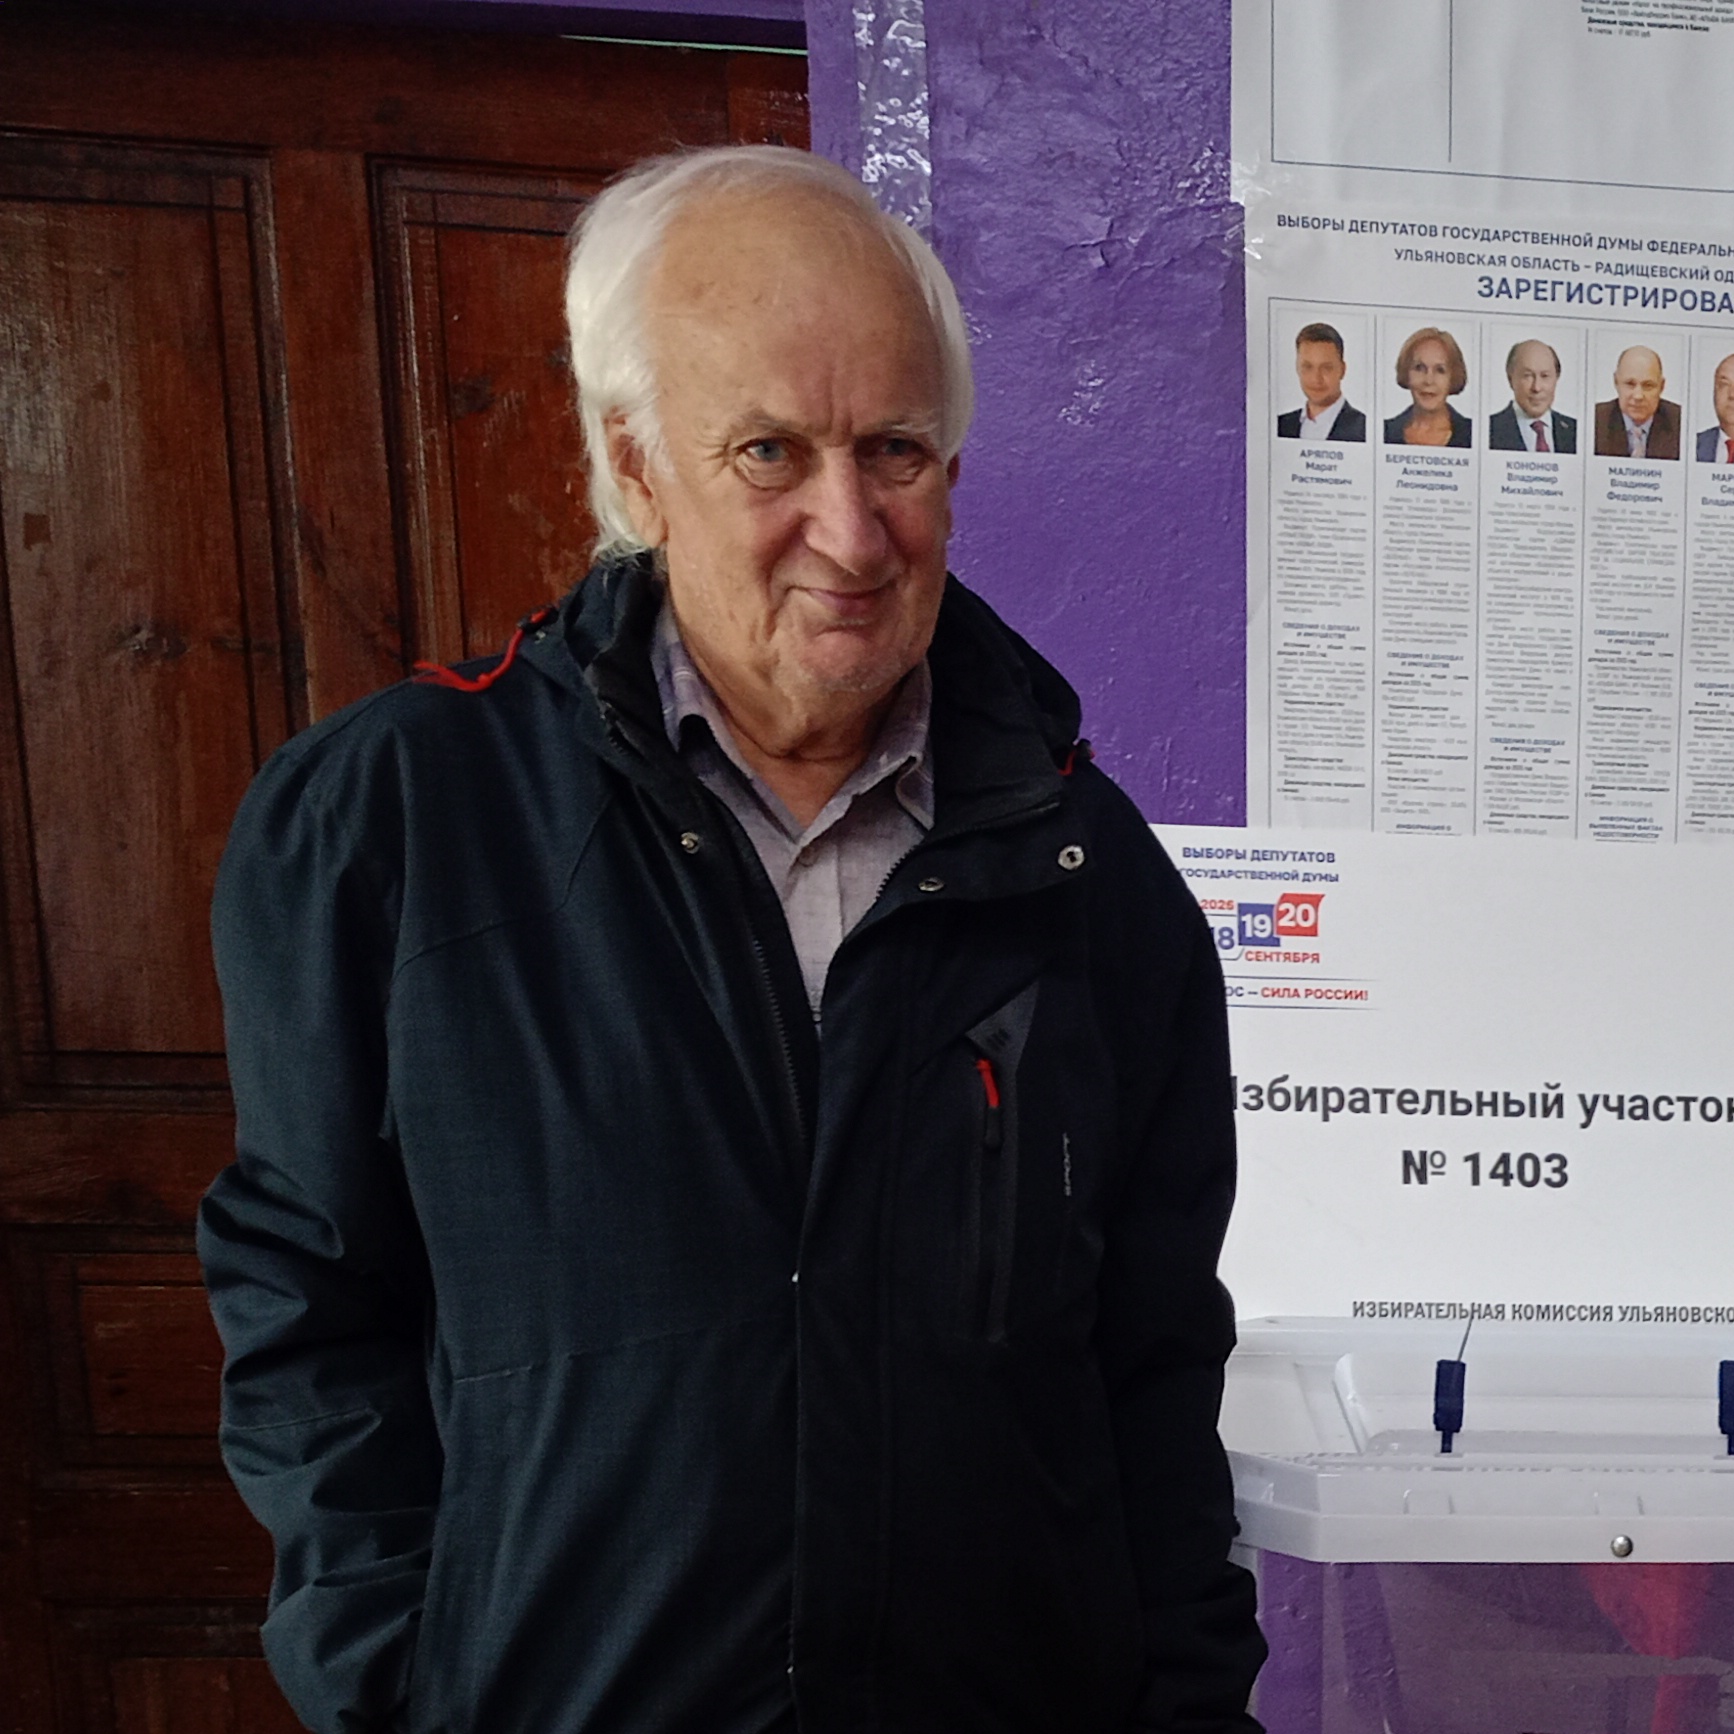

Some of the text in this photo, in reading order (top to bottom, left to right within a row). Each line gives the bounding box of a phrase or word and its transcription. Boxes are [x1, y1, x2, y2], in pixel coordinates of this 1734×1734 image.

[1277, 214, 1344, 231] ВЫБОРЫ
[1348, 220, 1438, 238] ДЕПУТАТОВ
[1442, 226, 1593, 248] ГОСУДАРСТВЕННОЙ
[1597, 236, 1643, 251] ДУМЫ
[1394, 248, 1506, 268] УЛЬЯНОВСКАЯ
[1511, 257, 1580, 273] ОБЛАСТЬ
[1595, 261, 1710, 282] РАДИЩЕВСКИЙ
[1300, 449, 1344, 460] АРЯПОВ
[1385, 453, 1469, 467] БЕРЕСТОВСКАЯ
[1305, 461, 1337, 473] Марат
[1402, 467, 1453, 478] Анжелика
[1506, 461, 1559, 472] КОНОНОВ
[1608, 467, 1662, 479] МАЛИНИН
[1291, 474, 1352, 486] Растямович
[1507, 473, 1558, 485] Владимир
[1610, 478, 1660, 490] Владимир
[1396, 480, 1458, 492] Леонидовна
[1501, 485, 1563, 496] Михайлович
[1607, 491, 1663, 504] Федорович
[1183, 847, 1335, 863] ВЫБОРЫ ДЕПУТАТОВ
[1179, 868, 1339, 883] ГОСУДАРСТВЕННОЙ ДУМЫ
[1241, 913, 1273, 938] 19
[1278, 902, 1316, 928] 20
[1245, 950, 1320, 964] СЕНТЯБРЯ
[1261, 986, 1368, 1001] СИЛА РОССИИ!
[1401, 1149, 1570, 1190] № 1403
[1352, 1301, 1507, 1320] ИЗБИРАТЕЛЬНАЯ
[1512, 1303, 1614, 1323] КОМИССИЯ
